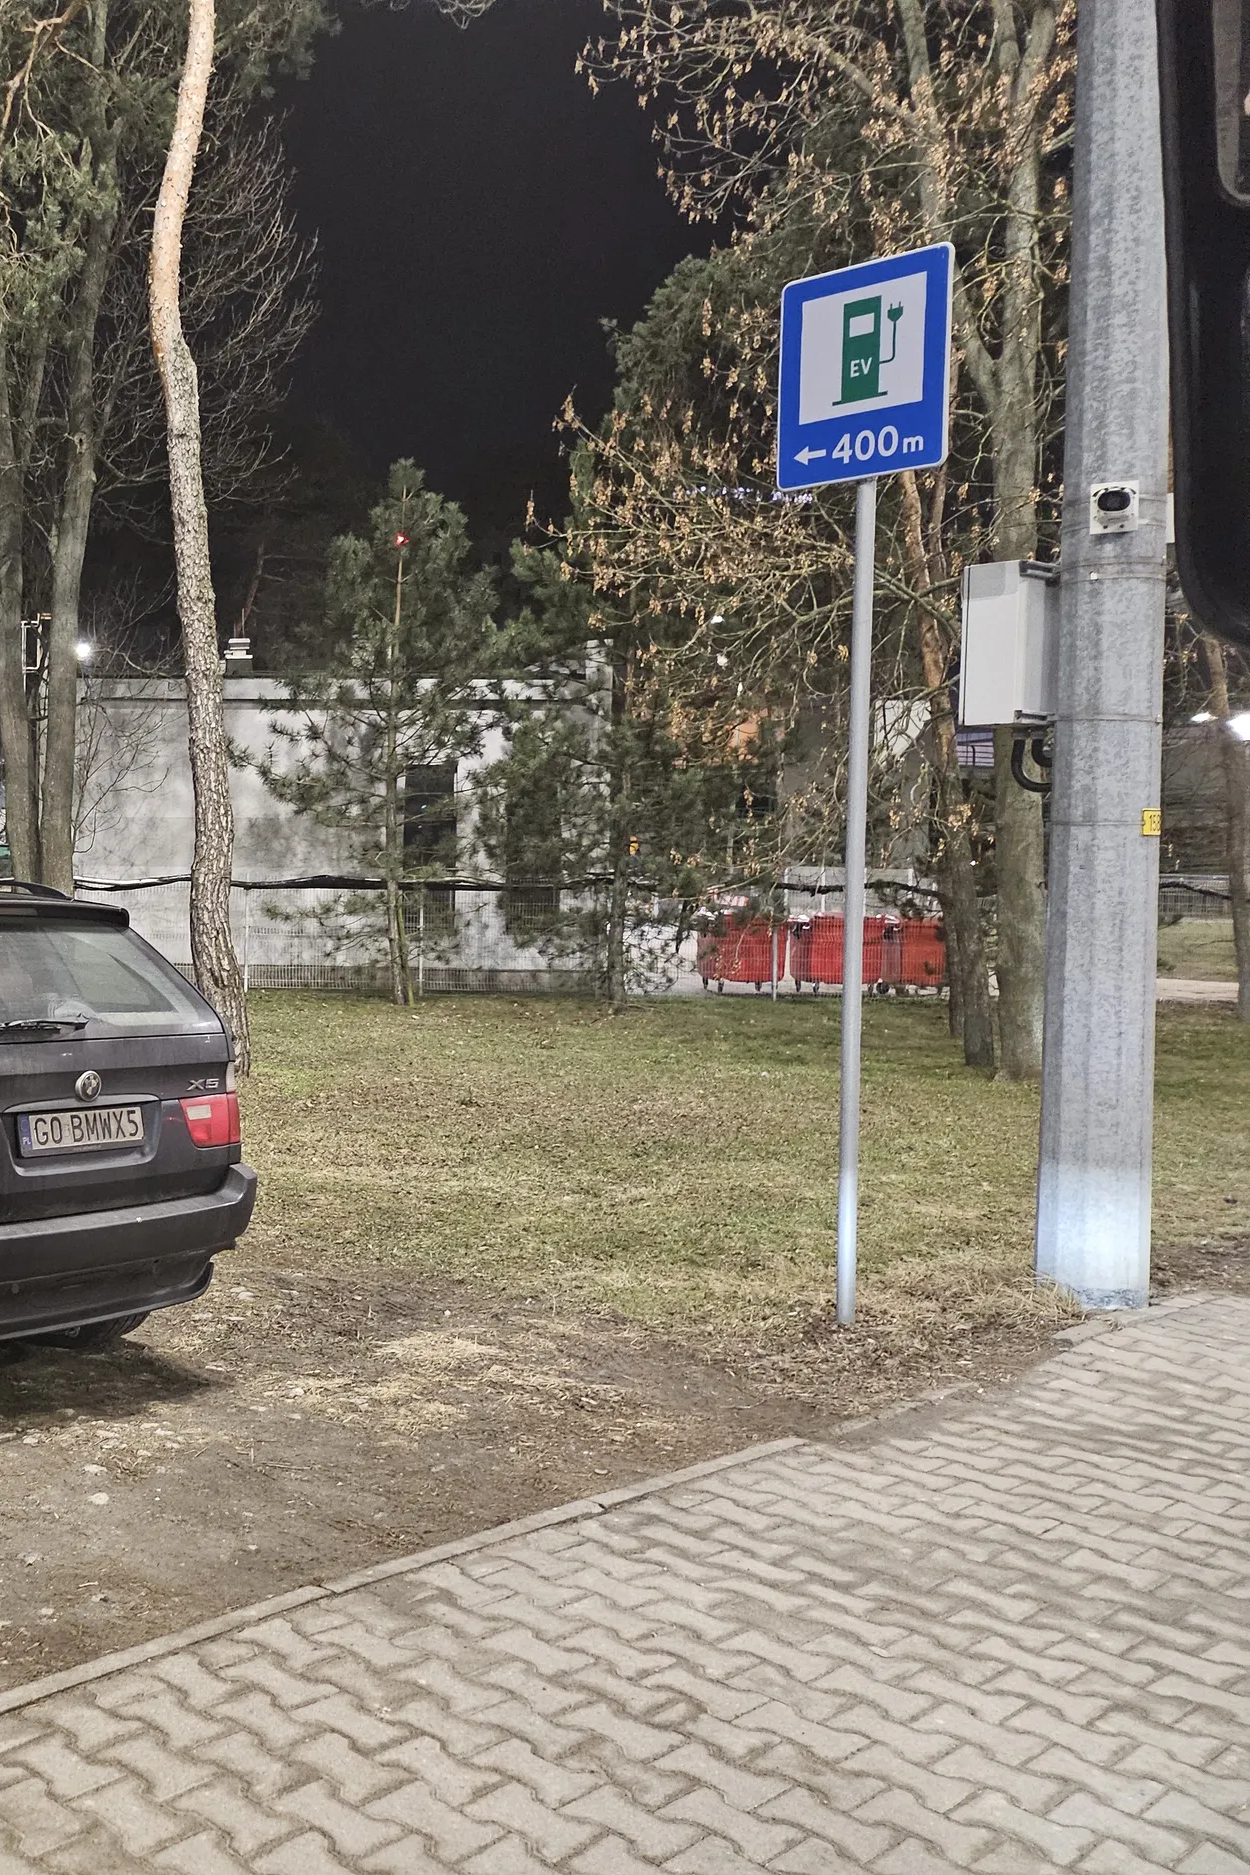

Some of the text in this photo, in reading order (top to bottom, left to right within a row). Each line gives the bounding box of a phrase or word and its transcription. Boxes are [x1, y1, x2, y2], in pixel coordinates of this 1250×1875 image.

[850, 357, 873, 378] EV
[832, 425, 924, 464] 400 m
[186, 1078, 220, 1091] X5
[70, 1109, 139, 1143] BMWX5
